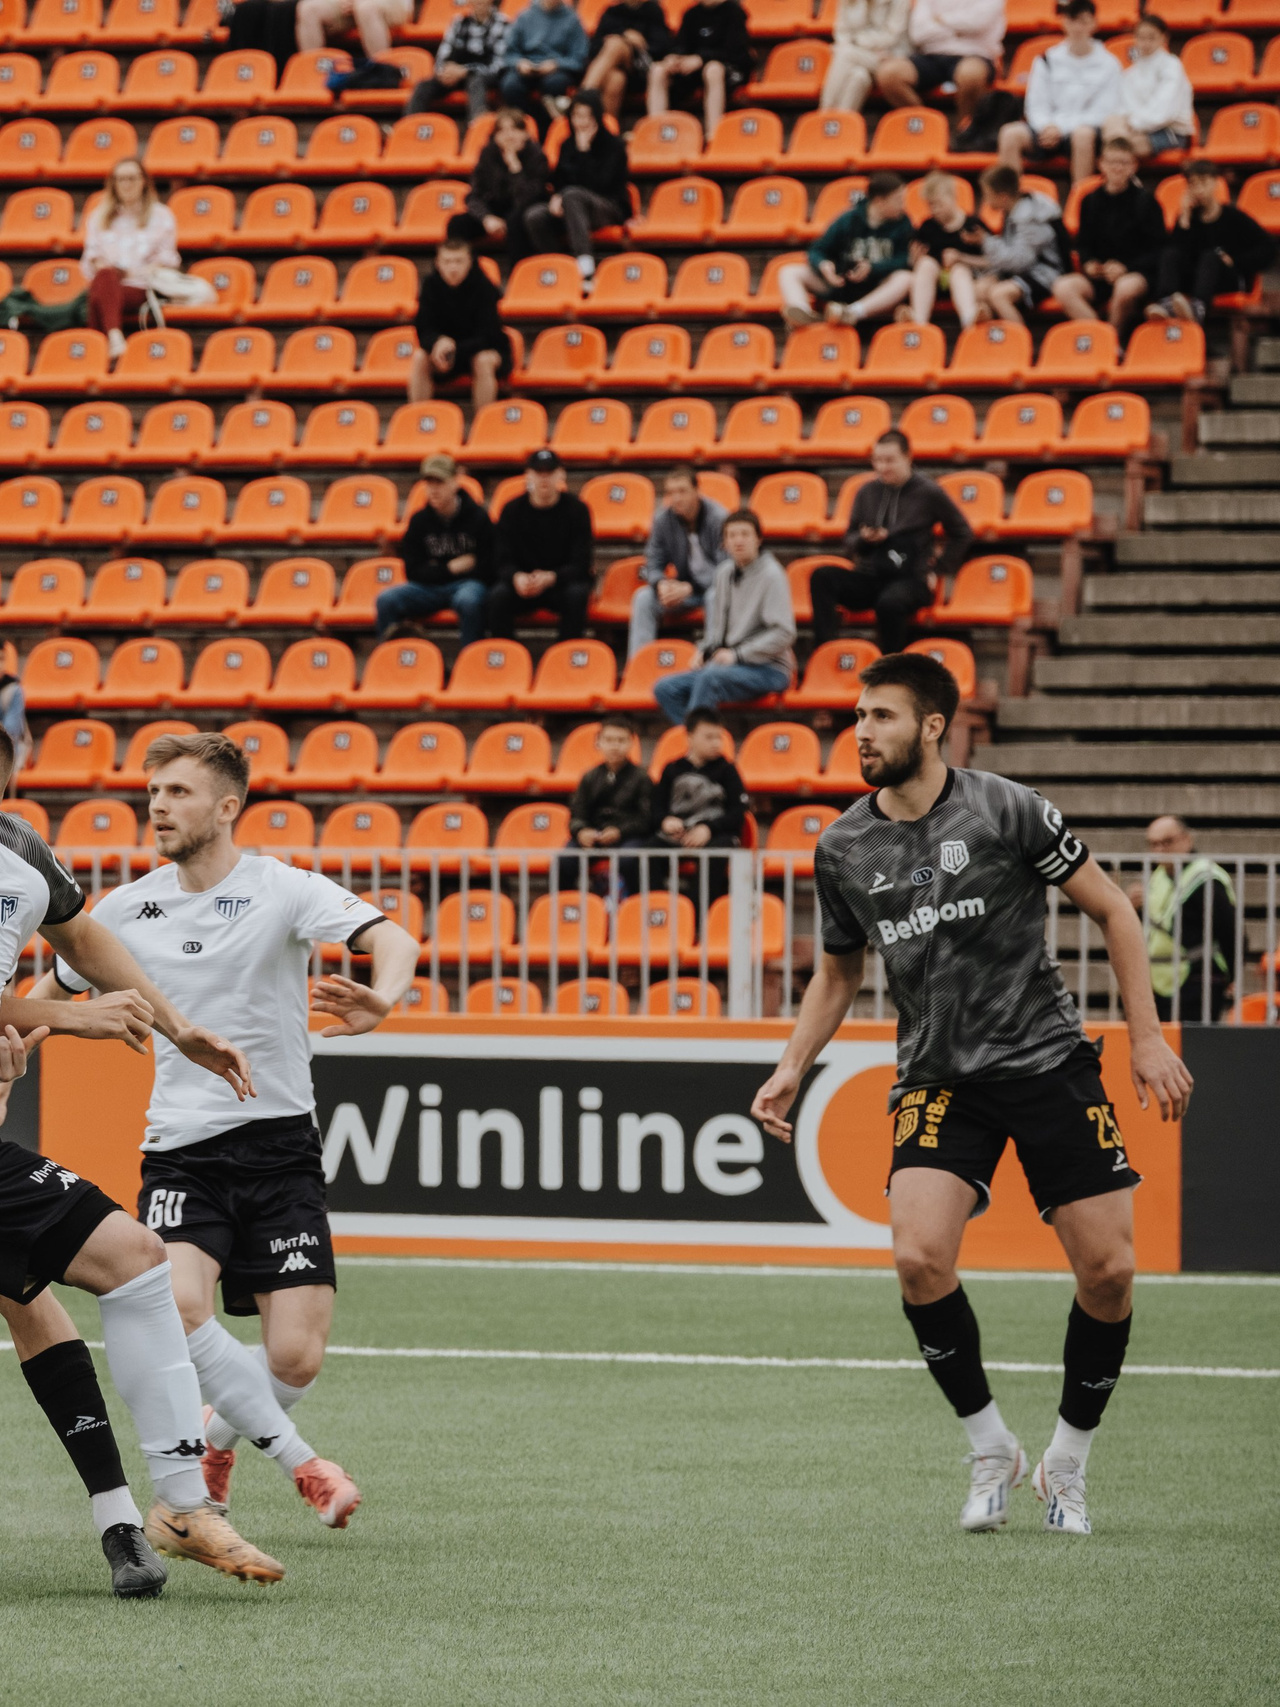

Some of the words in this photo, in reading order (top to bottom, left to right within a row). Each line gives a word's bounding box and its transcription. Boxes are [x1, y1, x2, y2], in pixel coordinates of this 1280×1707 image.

[321, 1083, 765, 1196] Winline
[1086, 1105, 1124, 1149] 25
[147, 1188, 187, 1230] 60
[66, 1420, 108, 1437] DEMIX
